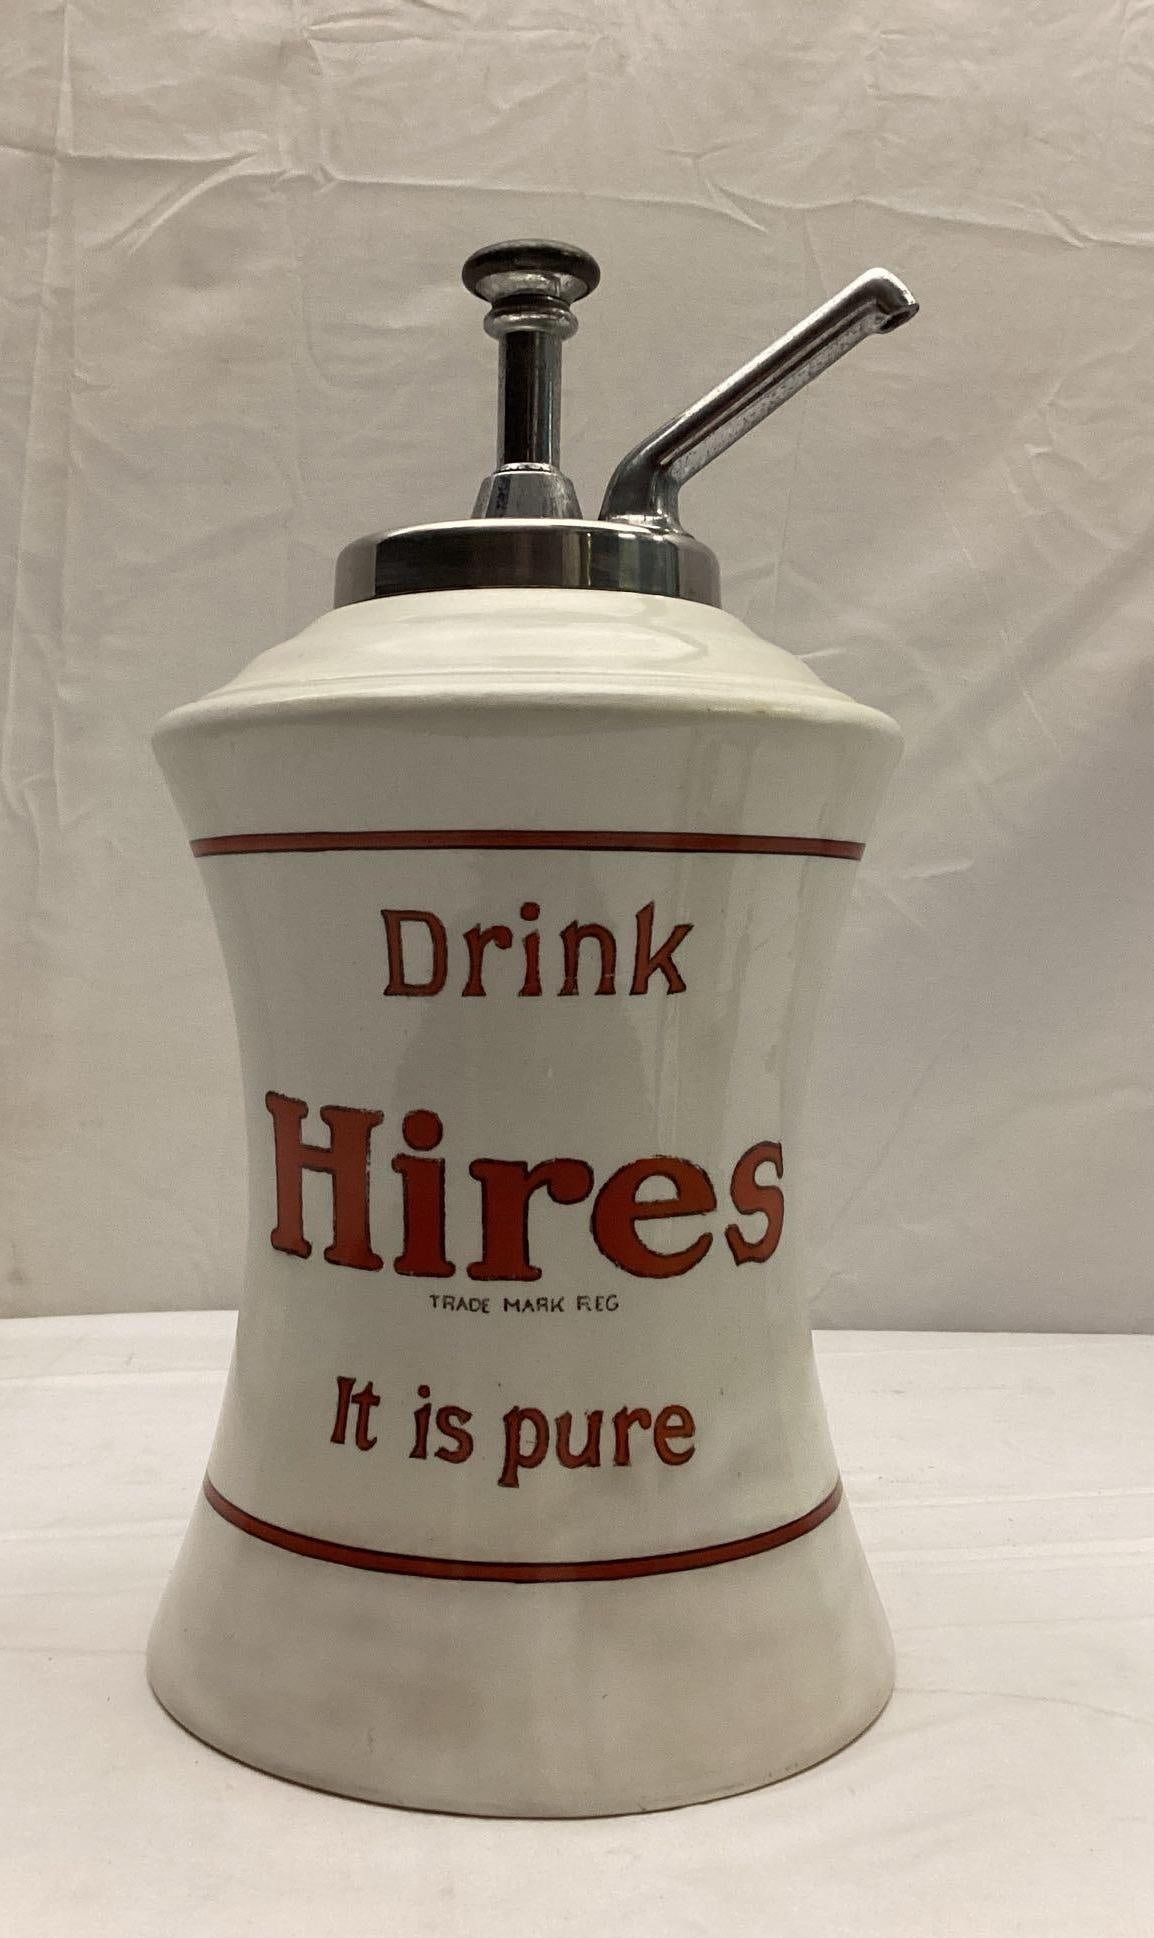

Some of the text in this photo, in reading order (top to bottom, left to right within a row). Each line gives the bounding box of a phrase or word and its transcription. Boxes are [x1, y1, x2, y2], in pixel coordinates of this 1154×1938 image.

[380, 899, 695, 1000] Drink
[264, 1090, 786, 1284] Hires
[429, 1294, 620, 1314] TRADE MARK REG
[330, 1375, 697, 1487] It is pure
